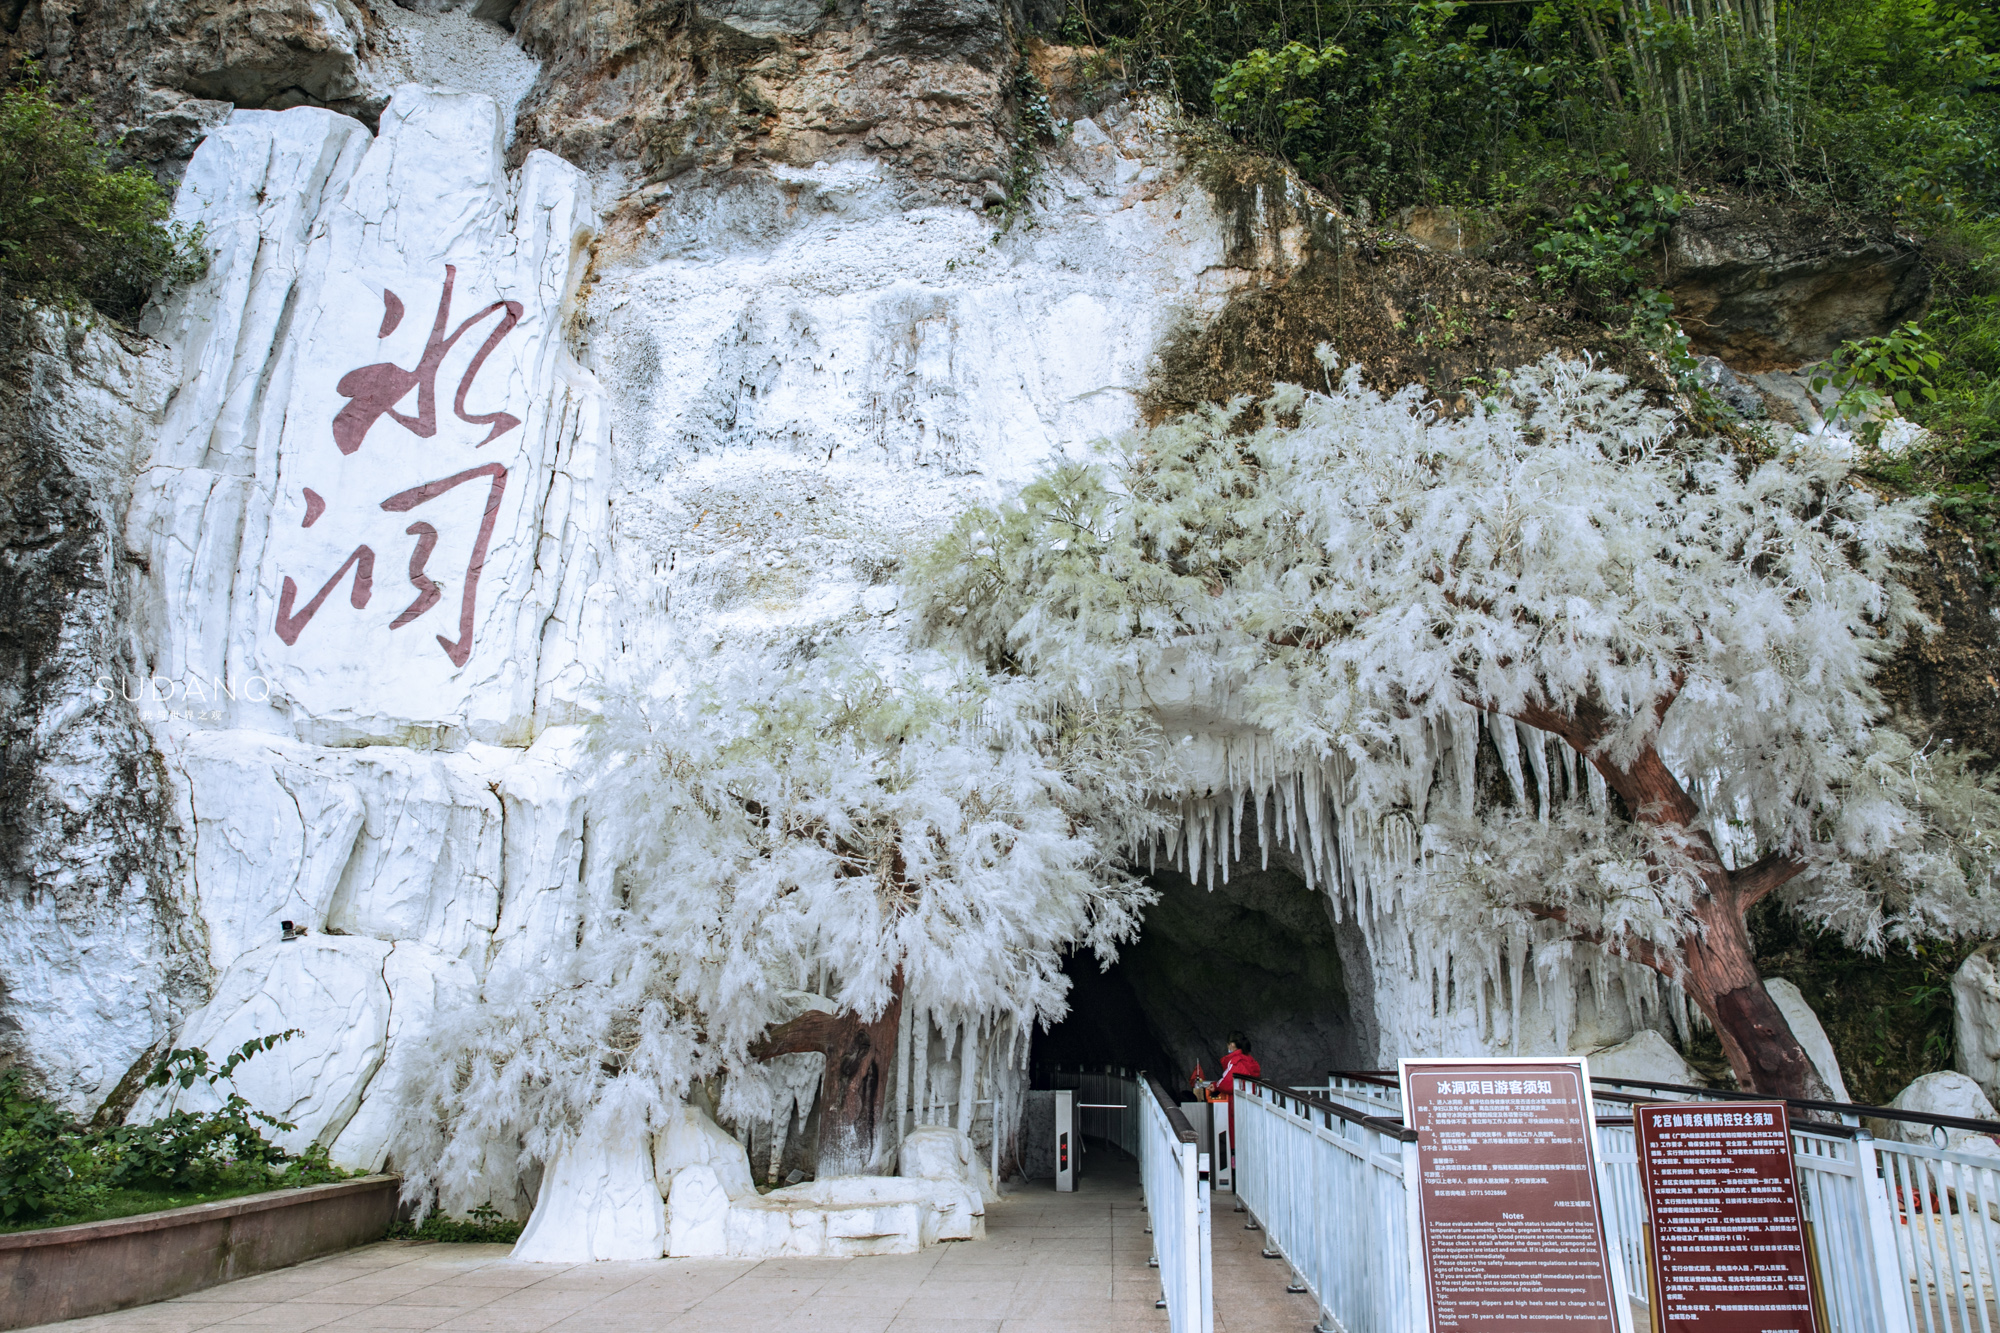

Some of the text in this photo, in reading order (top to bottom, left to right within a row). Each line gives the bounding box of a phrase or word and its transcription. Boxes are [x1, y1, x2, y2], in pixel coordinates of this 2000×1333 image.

[274, 264, 524, 667] 冰洞
[1437, 1080, 1552, 1095] 冰洞项目游客须知
[1653, 1113, 1773, 1127] 龙宫仙境疫情防控安全须知
